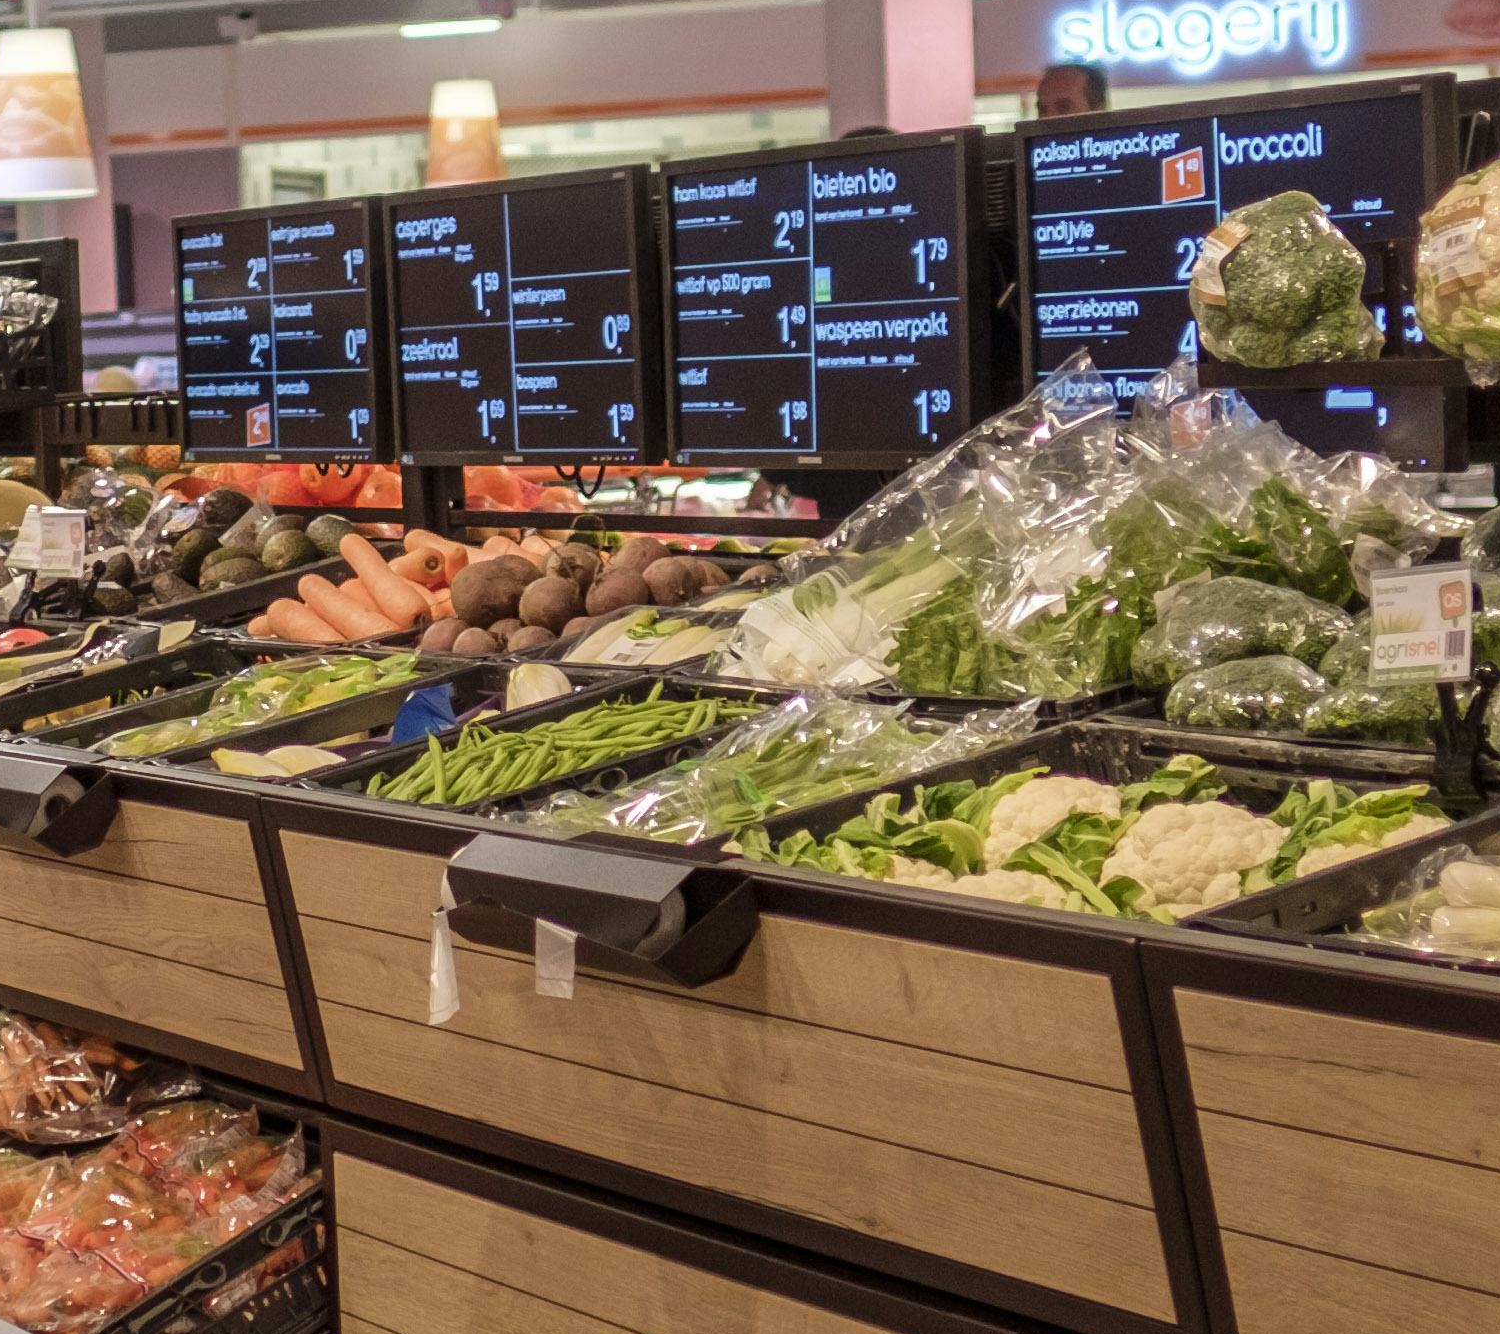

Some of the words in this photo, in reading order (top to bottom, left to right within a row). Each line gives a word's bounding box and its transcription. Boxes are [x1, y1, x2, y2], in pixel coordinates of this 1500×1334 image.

[1082, 132, 1149, 160] flowpack
[1152, 133, 1180, 156] per
[1220, 123, 1322, 164] broccoli
[813, 171, 866, 199] bieten
[869, 167, 896, 194] bio
[395, 216, 457, 243] asperges
[1035, 220, 1095, 245] andijvie
[911, 237, 948, 292] 1,79
[512, 287, 566, 306] winterpeen
[1037, 298, 1139, 324] sperziebonen
[815, 319, 882, 346] waspeen
[885, 310, 949, 343] verpakt
[401, 336, 459, 362] zeekraal
[1377, 634, 1441, 664] agrisnel
